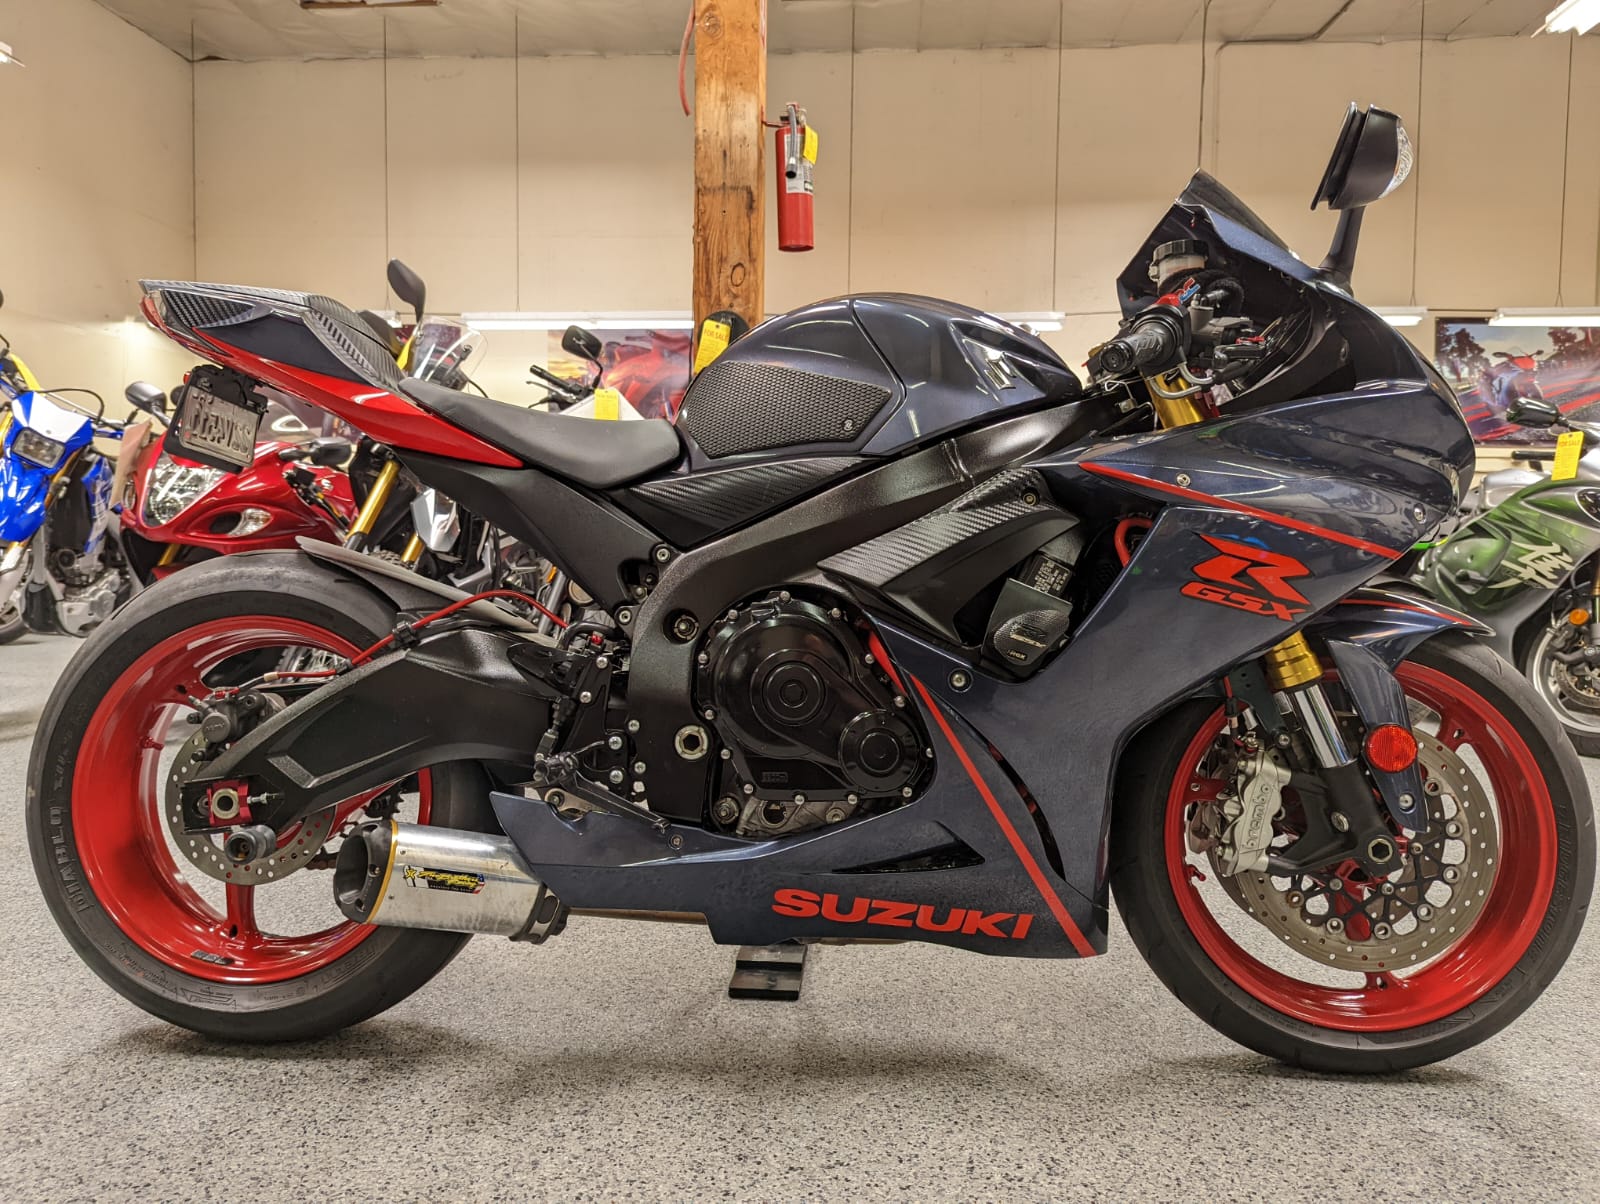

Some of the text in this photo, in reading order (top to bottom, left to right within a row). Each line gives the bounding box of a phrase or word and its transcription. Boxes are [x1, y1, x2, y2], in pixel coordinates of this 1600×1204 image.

[1180, 580, 1307, 622] GSX
[1244, 783, 1271, 850] brembo
[49, 805, 94, 913] DIABLO
[771, 888, 1034, 940] SUZUKI
